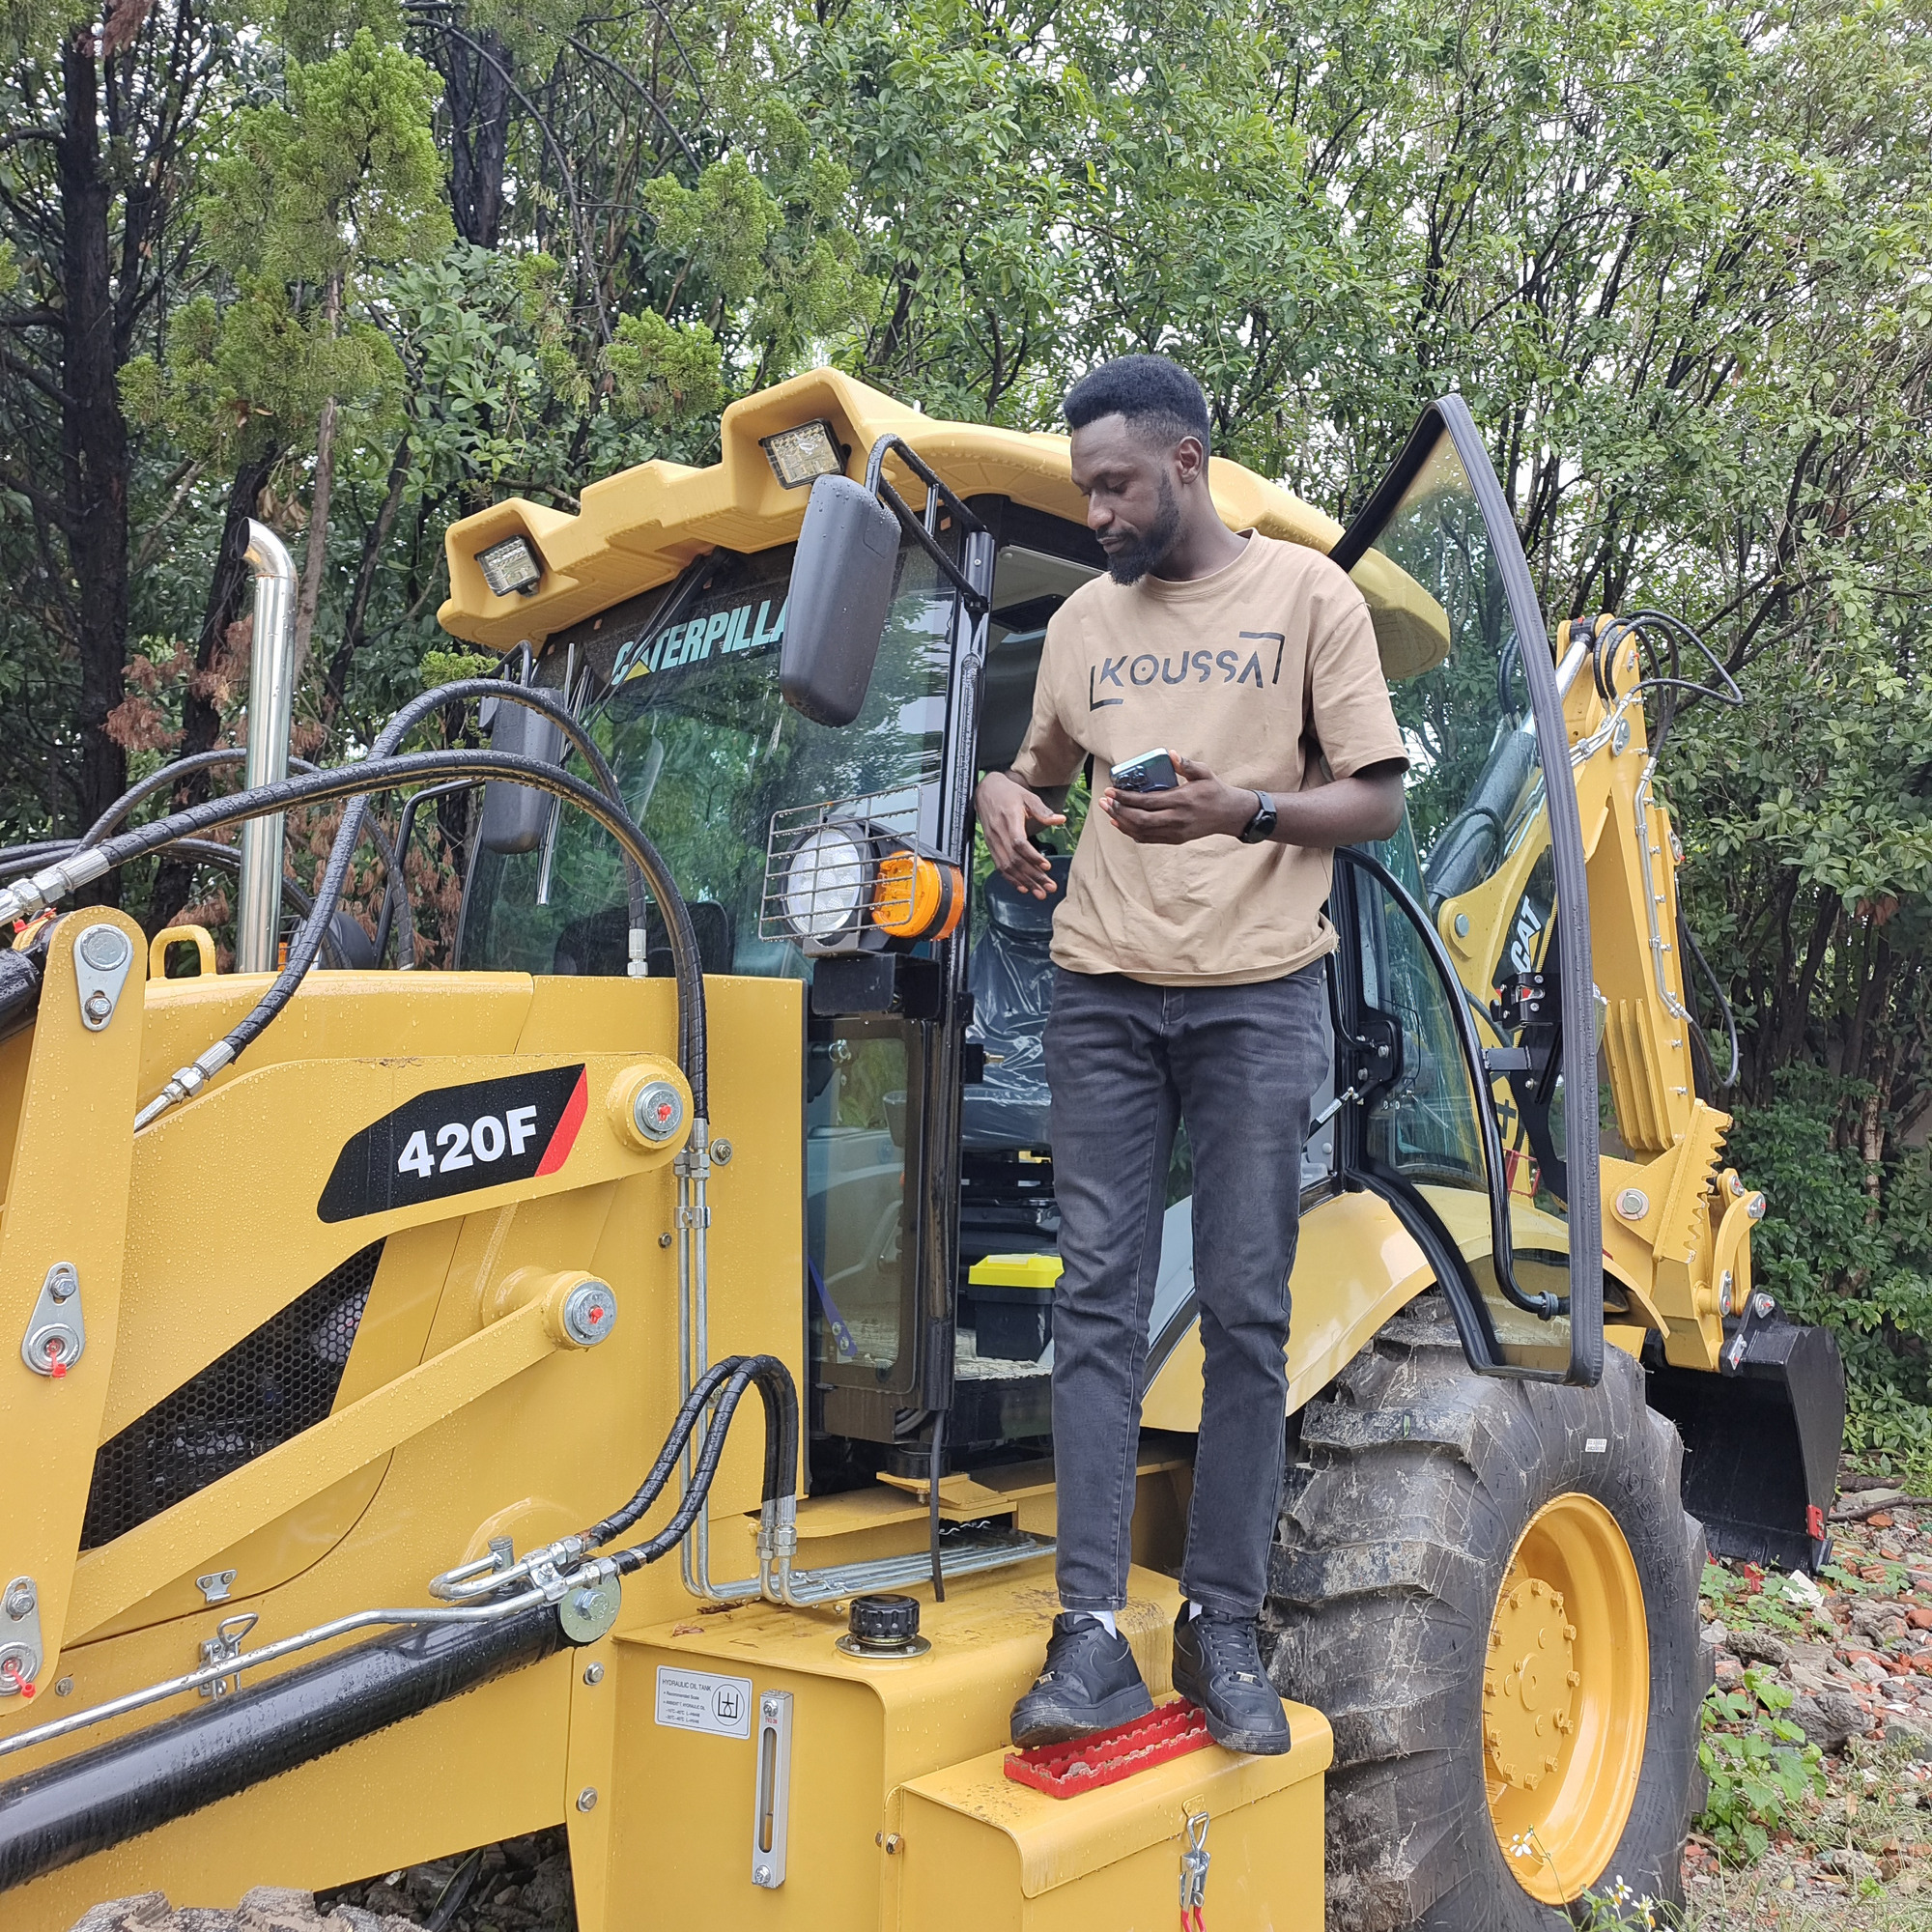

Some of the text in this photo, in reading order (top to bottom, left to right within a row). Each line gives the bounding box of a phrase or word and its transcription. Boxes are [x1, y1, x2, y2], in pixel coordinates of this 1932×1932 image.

[1099, 650, 1264, 689] KOUSSA
[1510, 895, 1542, 974] CAT
[397, 1104, 538, 1179] 420F
[662, 1679, 690, 1689] HYDRAULIC
[690, 1682, 698, 1690] OIL
